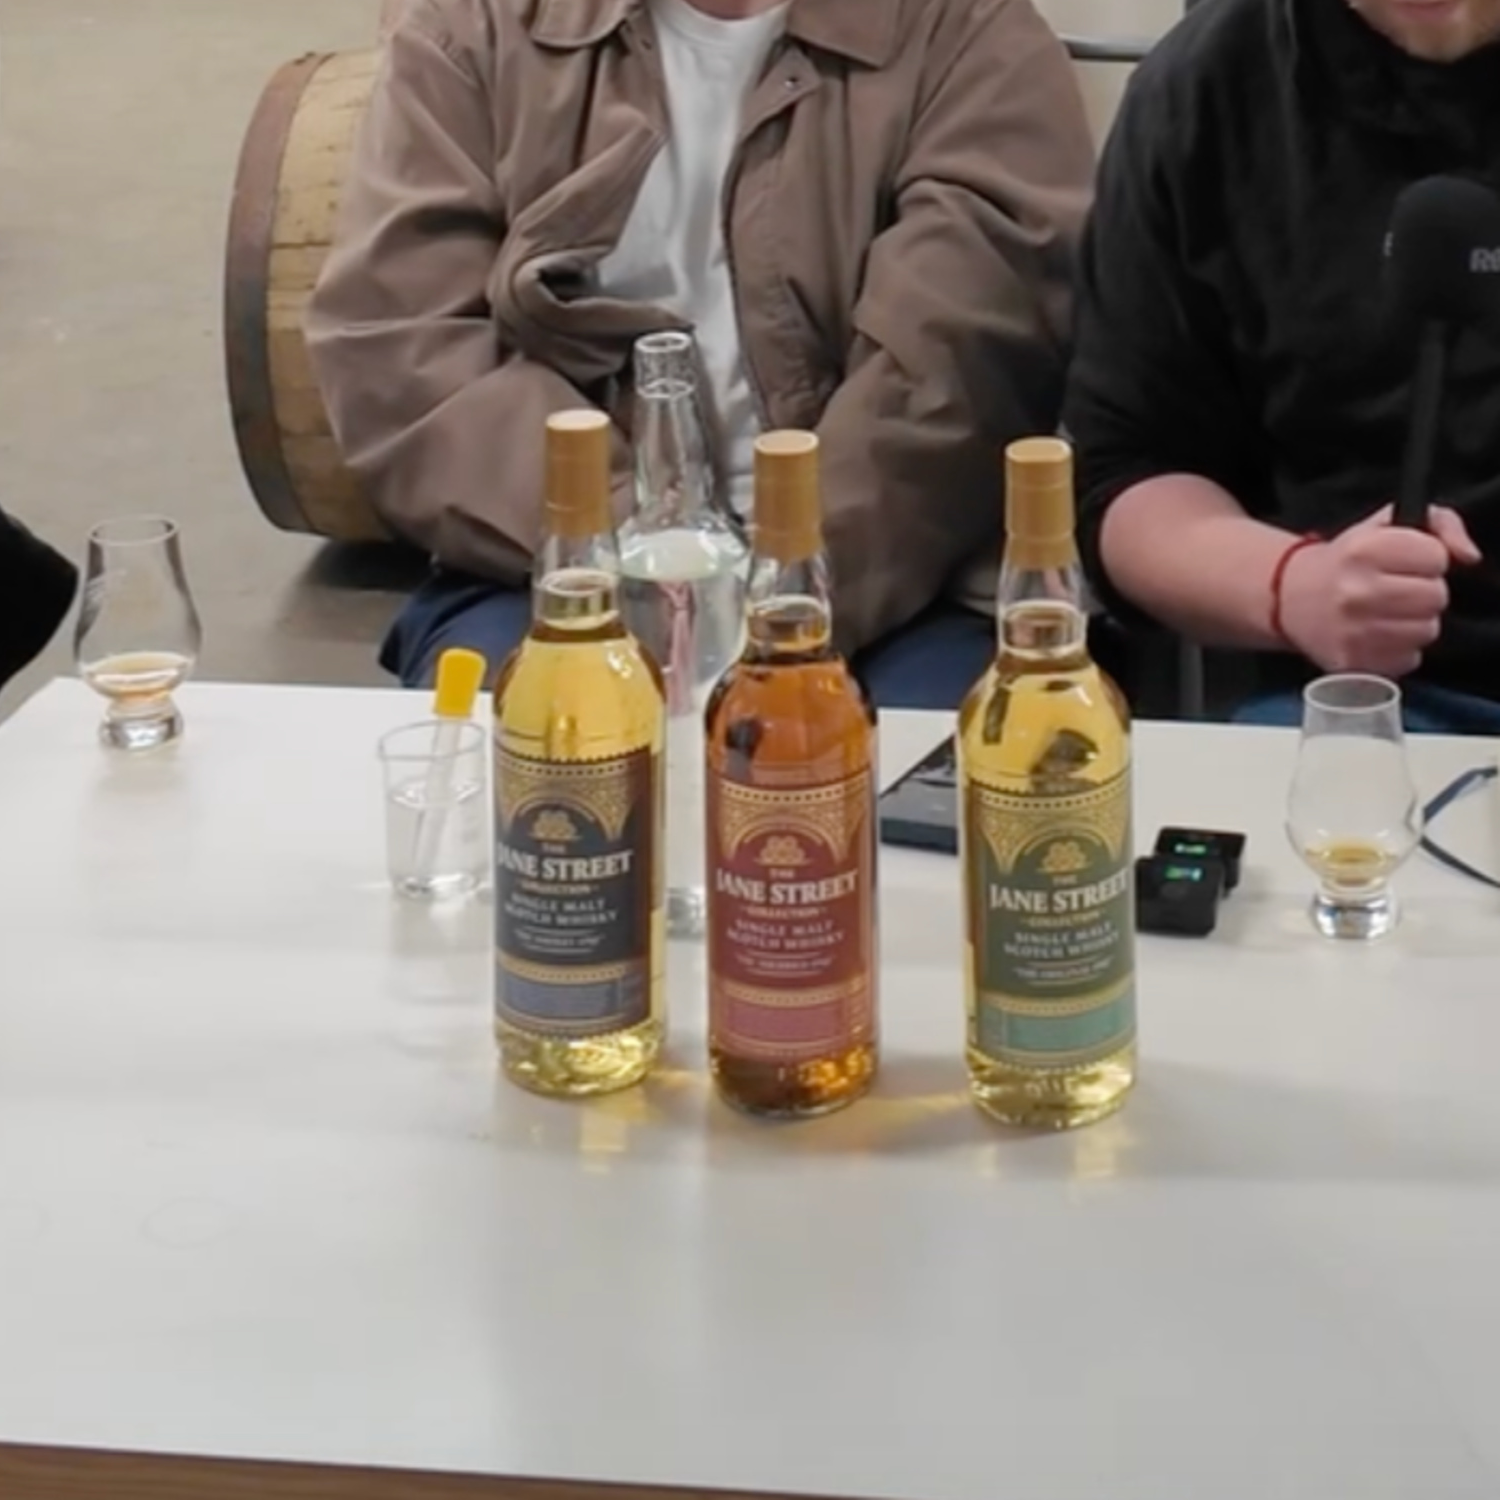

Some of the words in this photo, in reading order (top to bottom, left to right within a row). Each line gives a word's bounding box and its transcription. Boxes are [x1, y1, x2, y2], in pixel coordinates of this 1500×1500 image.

[542, 848, 634, 882] STREET
[717, 867, 765, 903] JANE
[770, 867, 858, 905] STREET
[990, 883, 1049, 914] JANE
[1052, 867, 1129, 914] STREET
